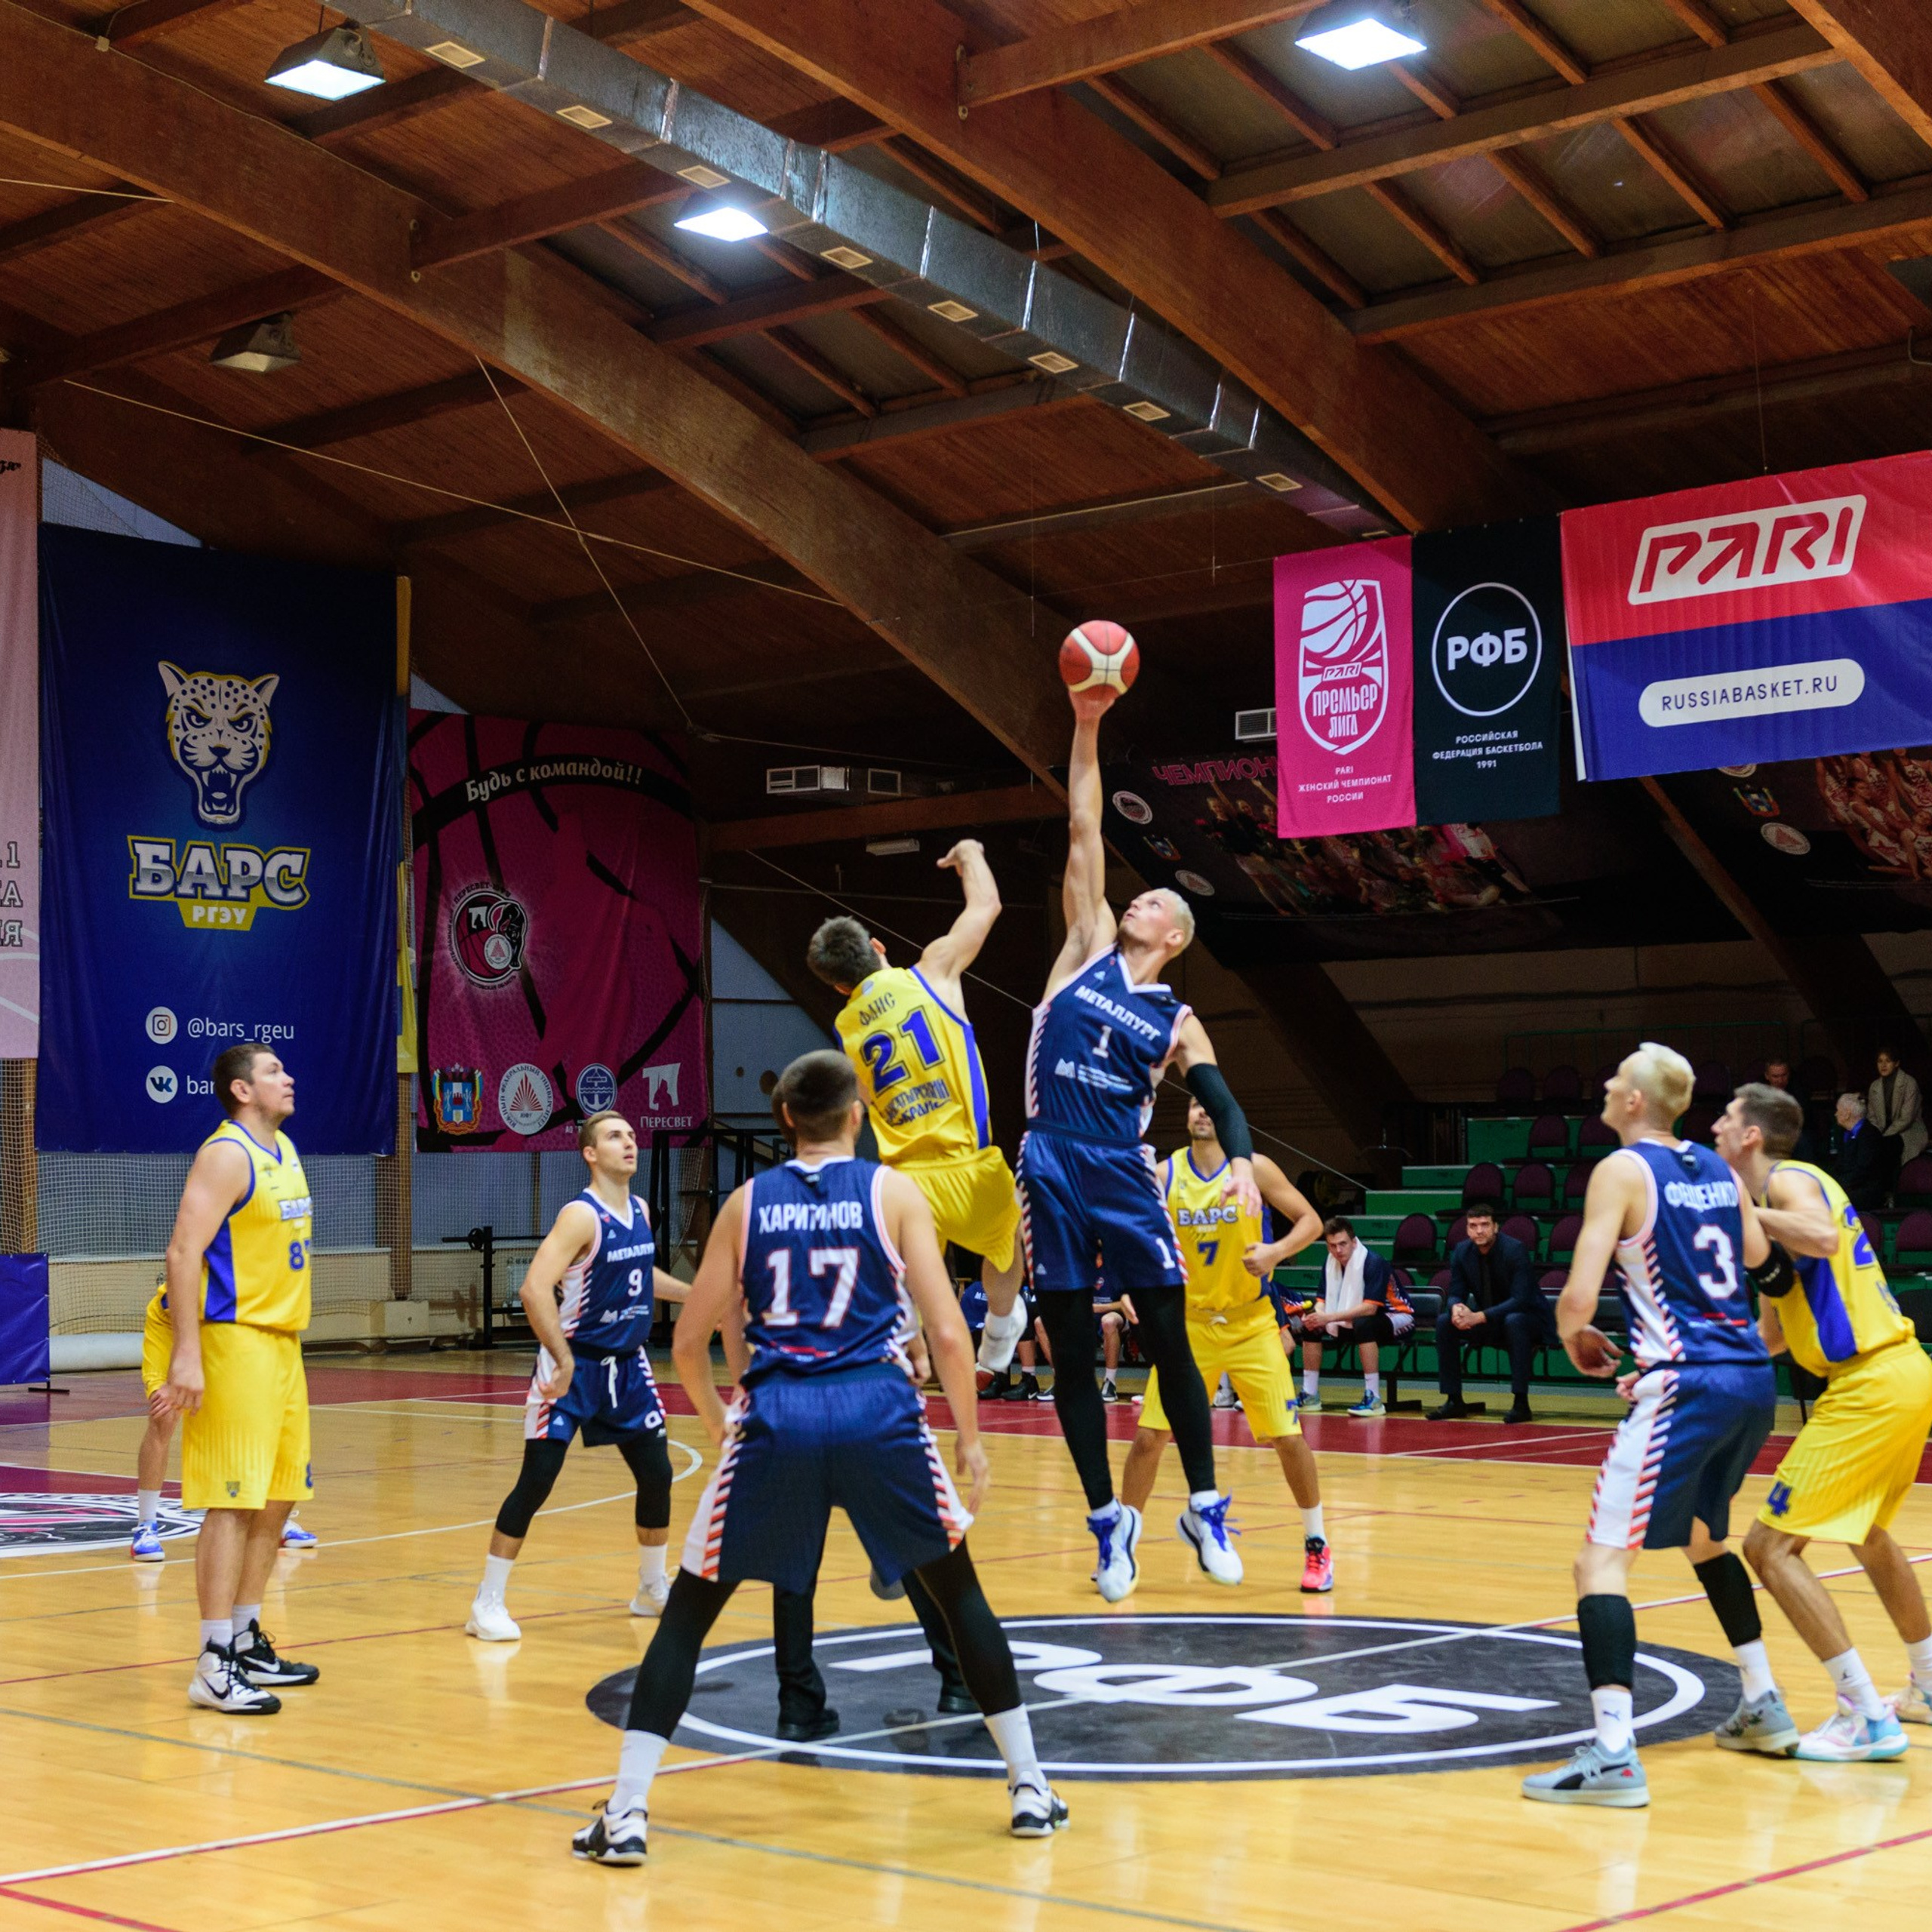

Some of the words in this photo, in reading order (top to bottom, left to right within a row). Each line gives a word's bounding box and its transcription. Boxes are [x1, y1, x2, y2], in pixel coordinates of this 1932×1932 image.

[1638, 506, 1854, 593] PARI
[1447, 627, 1528, 671] РФБ
[1324, 663, 1359, 679] PARI
[1662, 675, 1838, 711] RUSSIABASKET.RU
[1328, 714, 1358, 738] ЛИГА
[1456, 730, 1518, 744] РОССИЙСКАЯ
[1432, 746, 1484, 760] ФЕДЕРАЦИЯ
[1485, 741, 1543, 755] БАСКЕТБОЛА
[1477, 759, 1497, 769] 1991
[465, 771, 512, 801] Будь
[516, 768, 526, 782] с
[530, 758, 642, 785] командой!!
[1298, 780, 1340, 792] ЖЕНСКИЙ
[1341, 774, 1392, 787] ЧЕМПИОНАТ
[1335, 766, 1354, 775] PARI
[1327, 791, 1364, 804] РОССИИ
[0, 841, 20, 869] 1
[130, 838, 309, 909] БАРС
[192, 906, 248, 924] РГЭУ
[1074, 985, 1161, 1041] МЕТАЛЛУРГ
[187, 1017, 295, 1044] @bars_rgeu
[1092, 1025, 1112, 1059] 1
[860, 1005, 946, 1098] 21
[639, 1115, 693, 1128] ПЕРЕСВЕТ
[1177, 1205, 1238, 1226] БАРС
[1155, 1237, 1176, 1269] 1
[1198, 1239, 1221, 1266] 7
[1693, 1225, 1738, 1300] 3
[628, 1269, 643, 1297] 9
[762, 1247, 860, 1327] 17
[1767, 1481, 1792, 1517] 4
[828, 1641, 1561, 1734] РФБ
